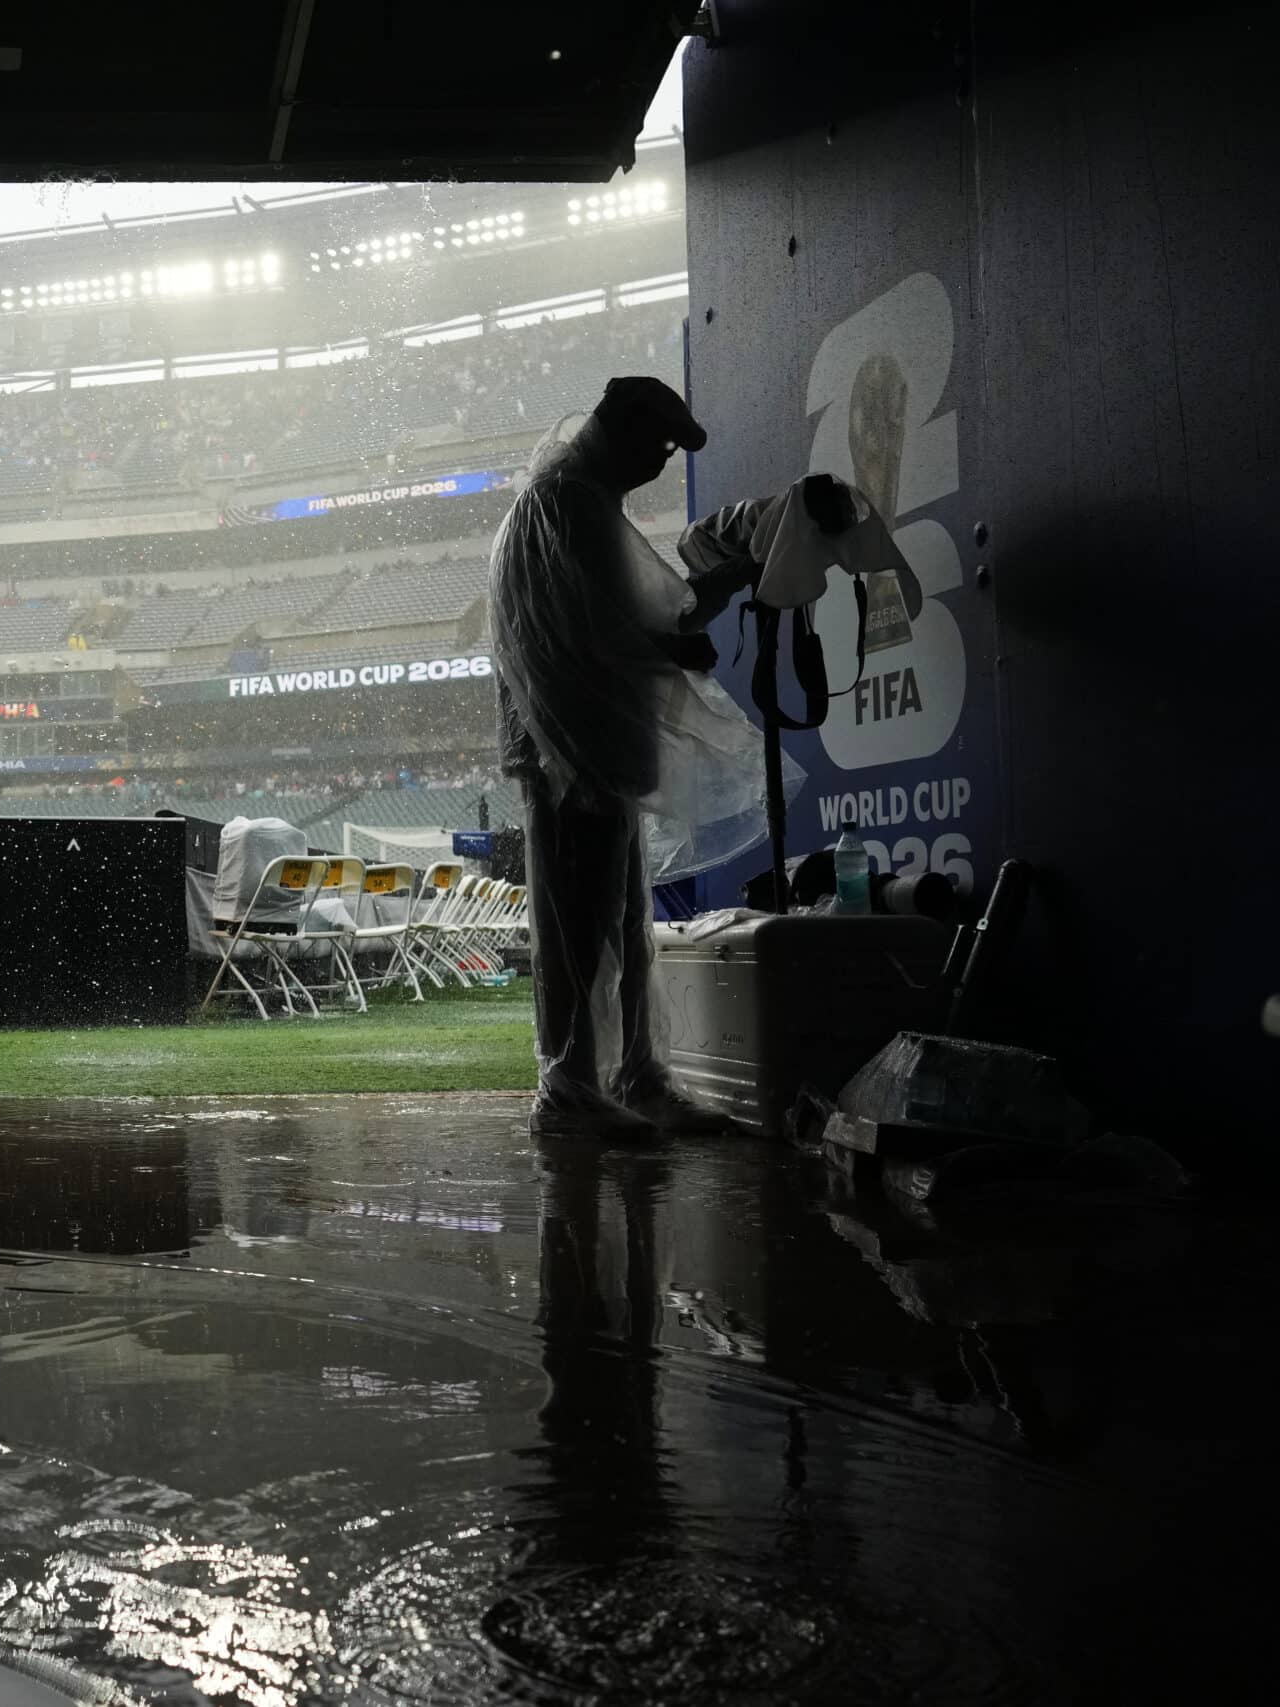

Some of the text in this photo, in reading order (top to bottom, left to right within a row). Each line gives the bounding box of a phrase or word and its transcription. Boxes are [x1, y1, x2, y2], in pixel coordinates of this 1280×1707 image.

[309, 480, 457, 511] FIFA WORLD CUP 2026
[228, 655, 493, 697] FIFA WORLD CUP 2026
[854, 667, 923, 725] FIFA
[818, 777, 972, 832] WORLD CUP
